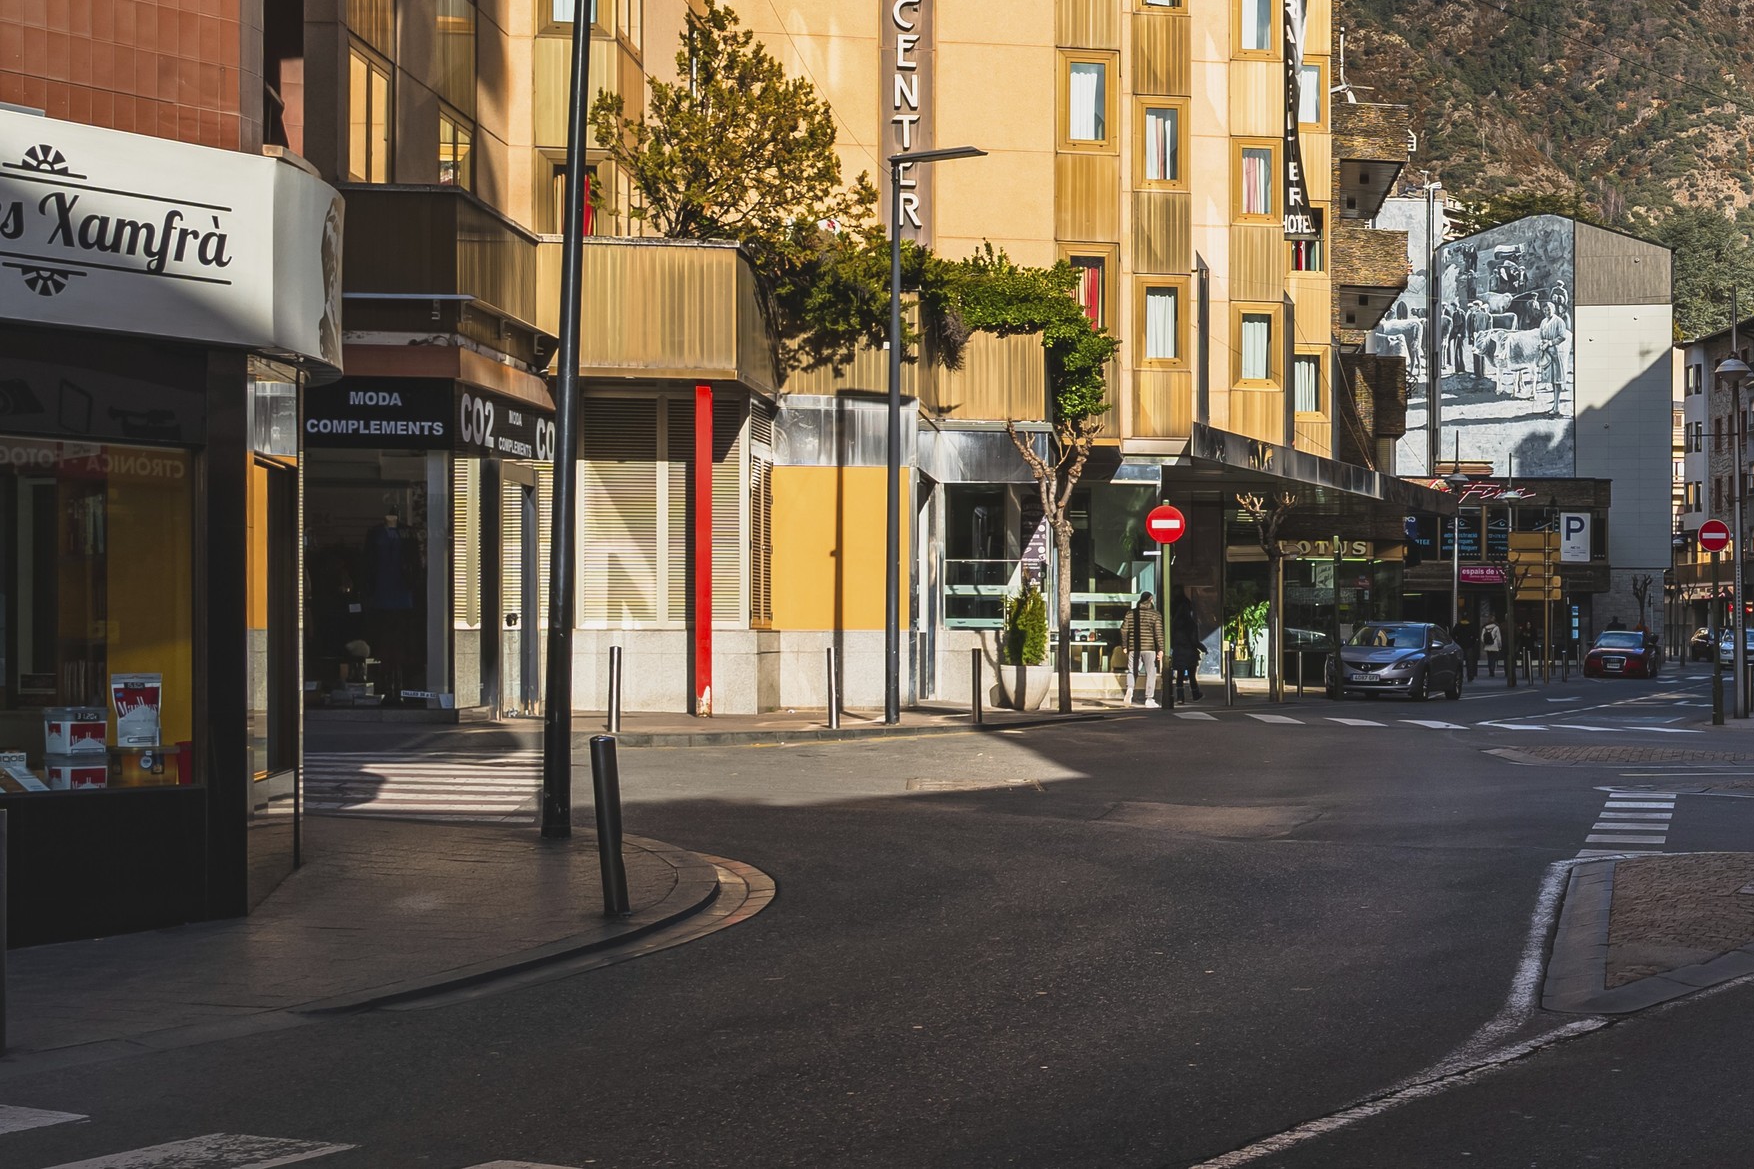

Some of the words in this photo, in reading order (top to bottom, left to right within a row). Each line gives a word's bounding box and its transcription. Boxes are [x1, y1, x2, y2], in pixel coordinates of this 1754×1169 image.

[0, 201, 24, 239] s
[38, 192, 233, 273] Xamfrà
[1284, 214, 1315, 234] HOTEL
[349, 391, 402, 406] MODA
[306, 419, 444, 436] COMPLEMENTS
[461, 393, 495, 448] CO2
[508, 410, 523, 426] MODA
[499, 437, 532, 458] COMPLEMENTS
[536, 418, 555, 461] CO
[1566, 516, 1585, 541] P
[1279, 540, 1367, 556] OTUS
